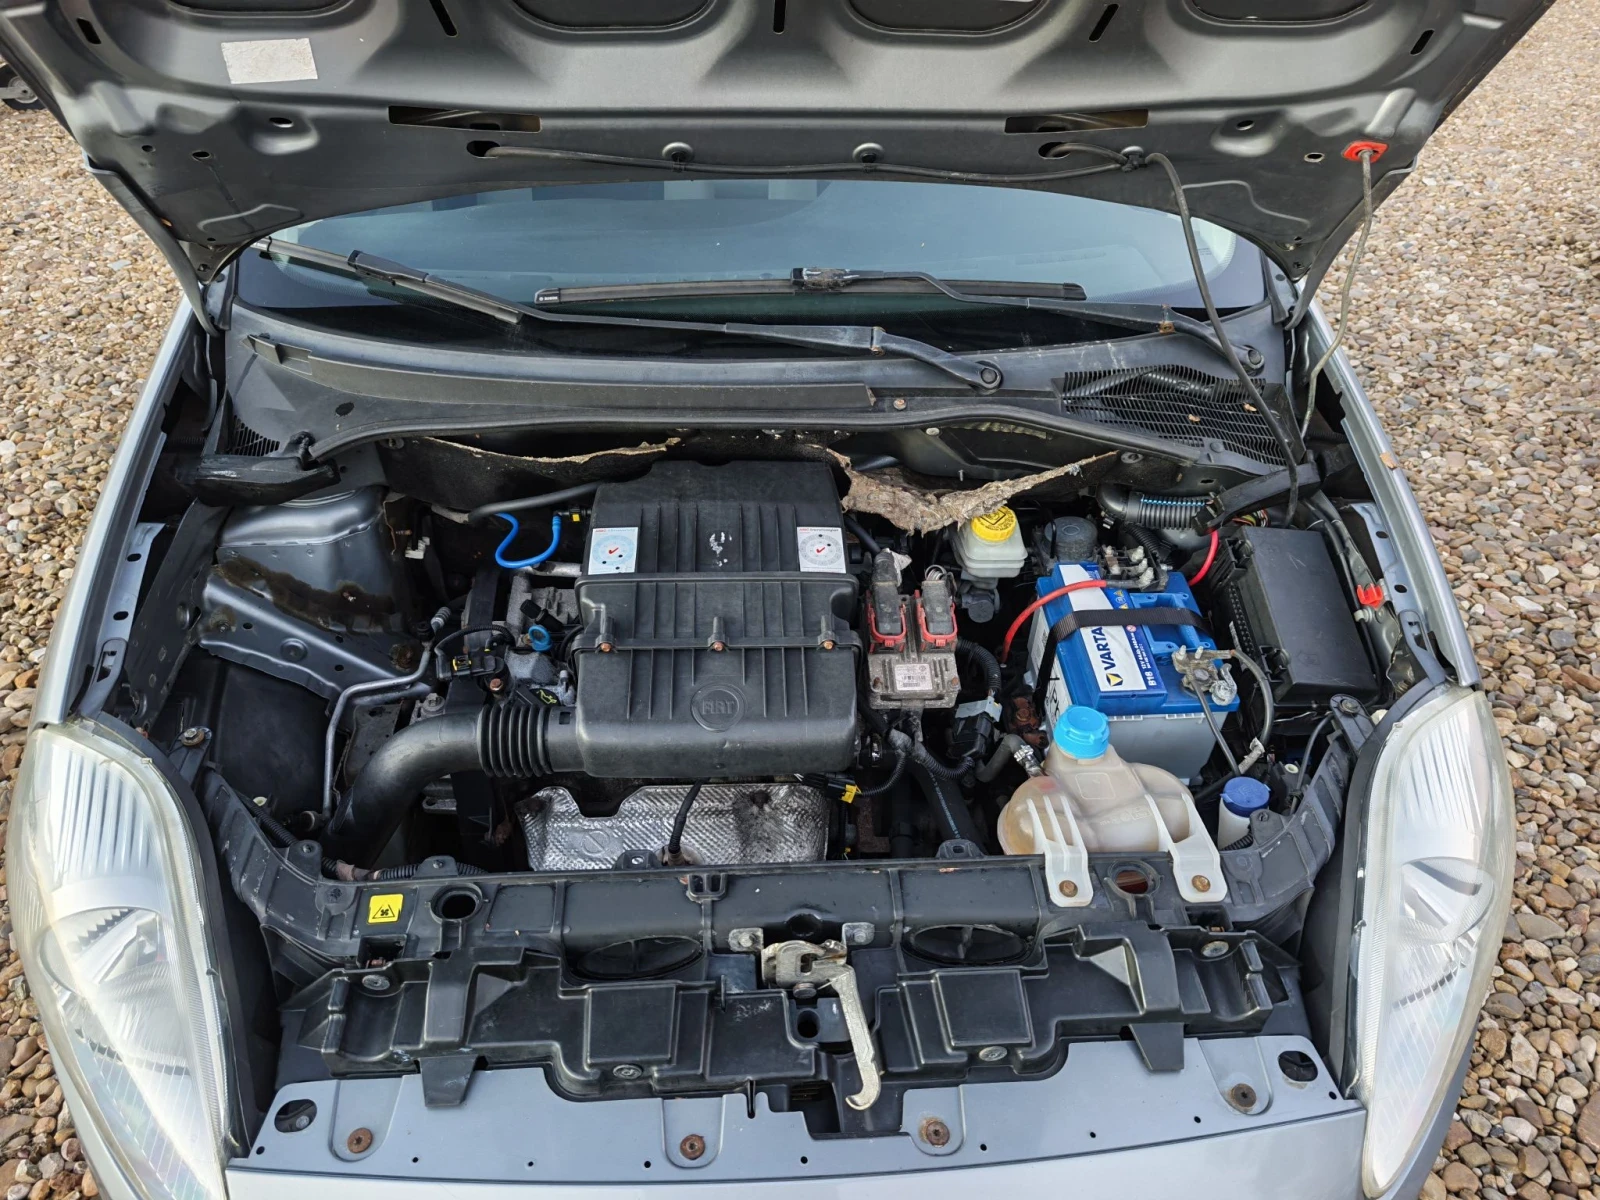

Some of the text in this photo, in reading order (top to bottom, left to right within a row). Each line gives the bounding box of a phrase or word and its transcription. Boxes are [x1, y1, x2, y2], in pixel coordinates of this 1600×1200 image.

[1091, 626, 1116, 670] VARTA
[1144, 671, 1157, 686] B18
[702, 699, 735, 715] FIAT
